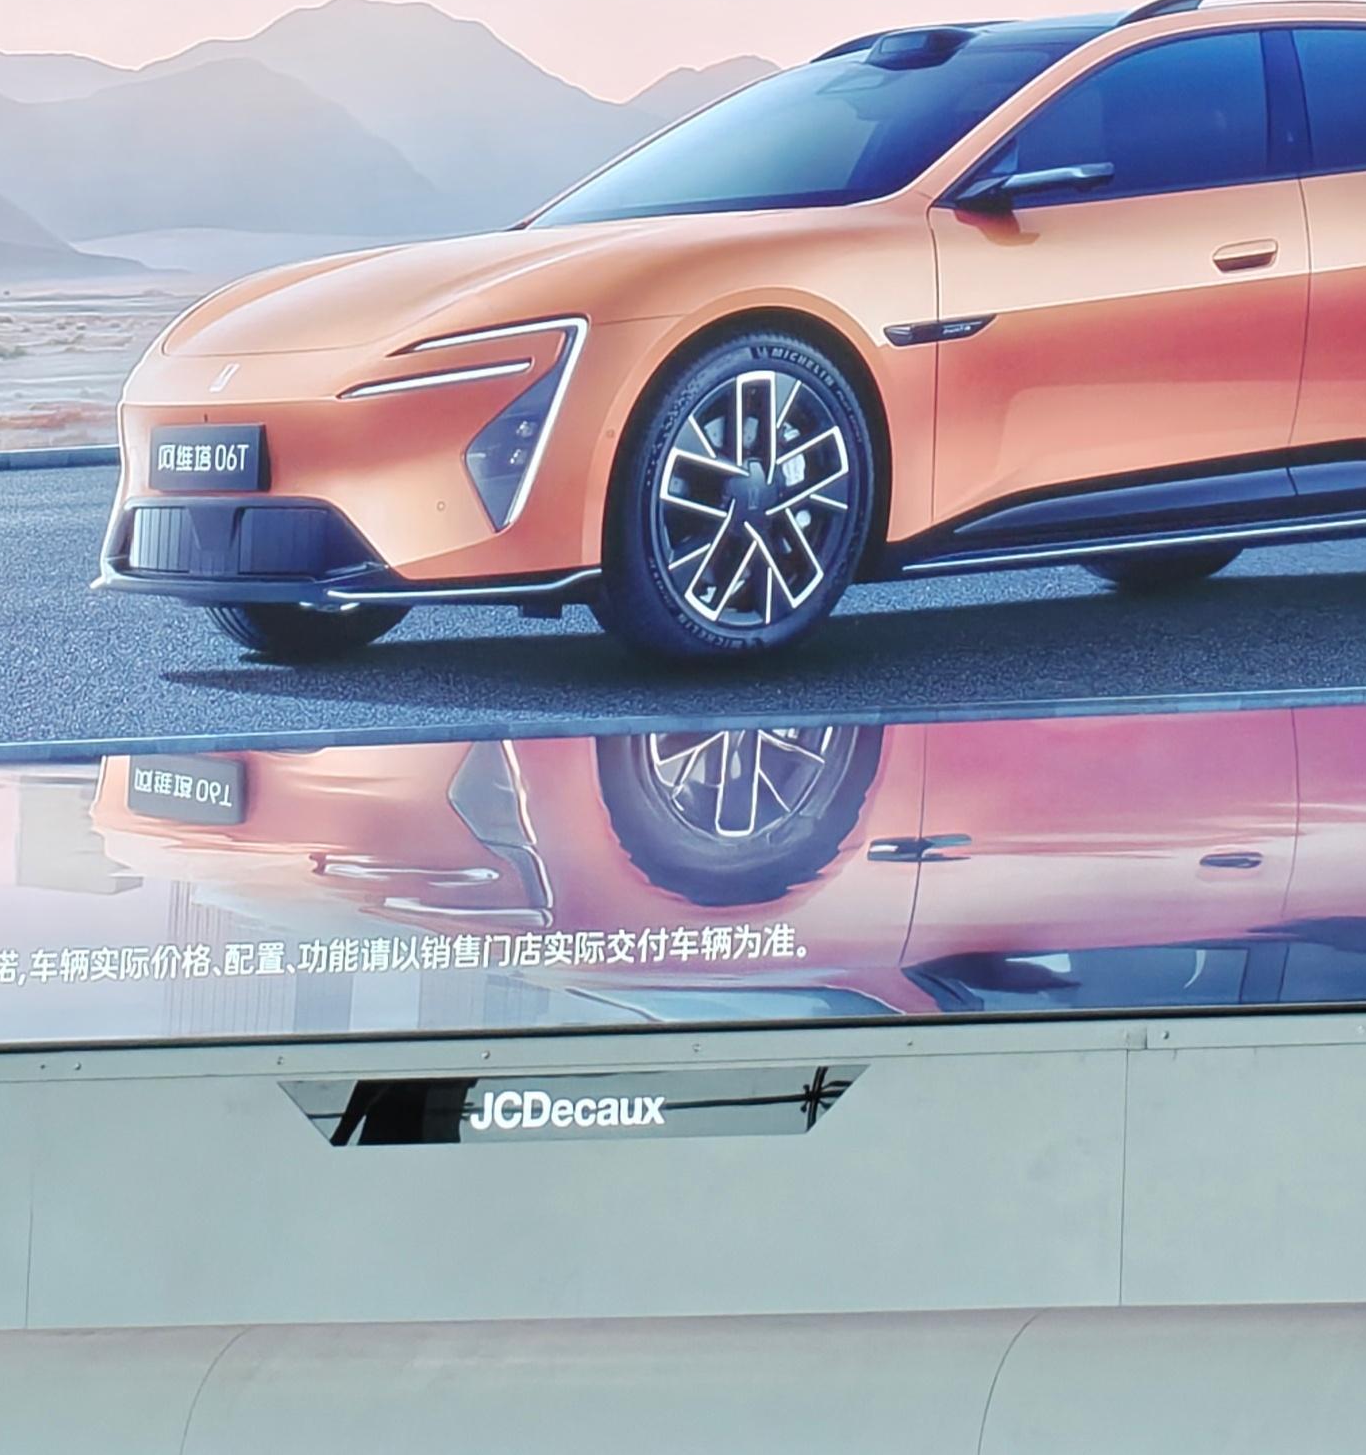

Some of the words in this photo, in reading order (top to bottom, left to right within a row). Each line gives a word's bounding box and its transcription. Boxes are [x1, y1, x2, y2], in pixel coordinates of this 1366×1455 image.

[157, 443, 212, 472] 阿维塔
[214, 443, 249, 472] 06T
[469, 1091, 666, 1130] JCDecaux
